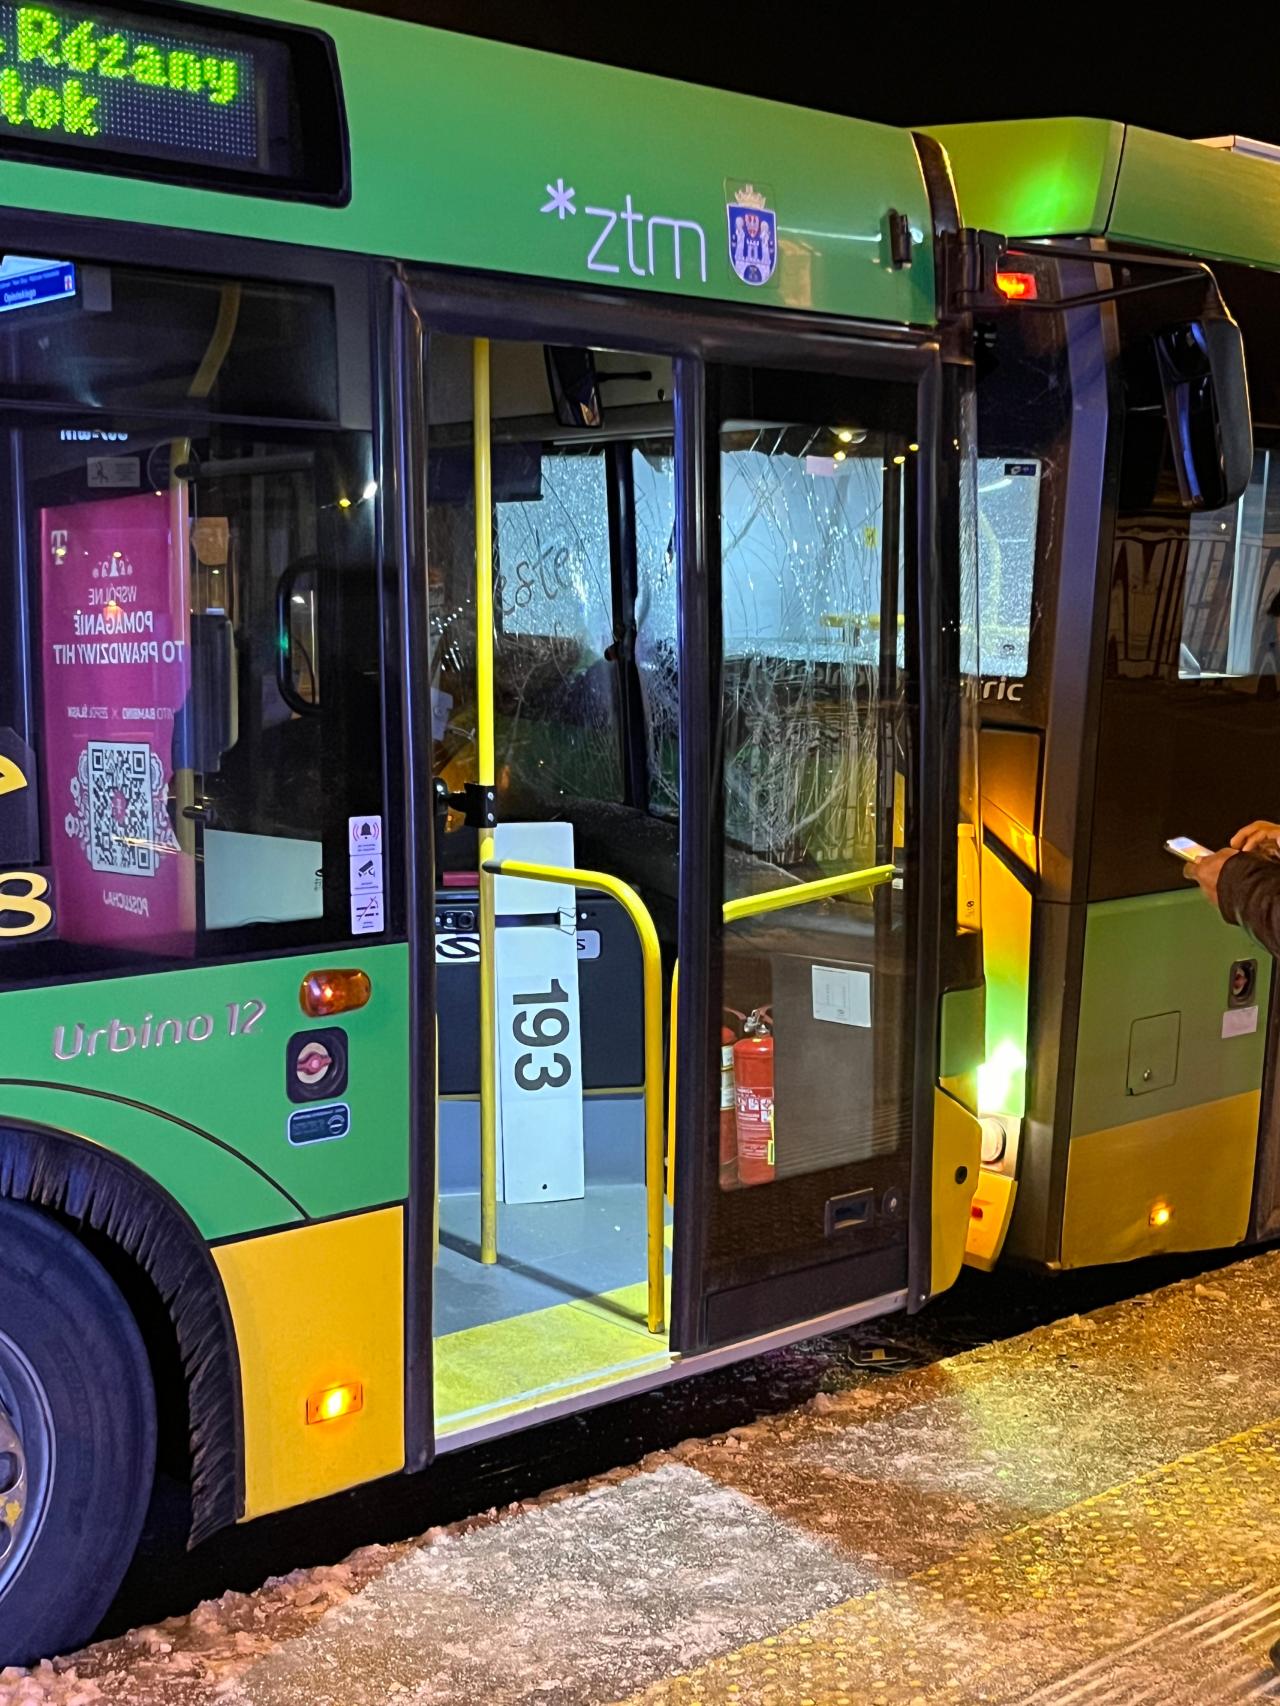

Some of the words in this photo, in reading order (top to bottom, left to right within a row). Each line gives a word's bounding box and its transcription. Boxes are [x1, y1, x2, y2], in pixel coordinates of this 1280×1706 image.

[52, 1012, 215, 1061] Urbino
[225, 998, 267, 1037] 12
[512, 978, 572, 1091] 193
